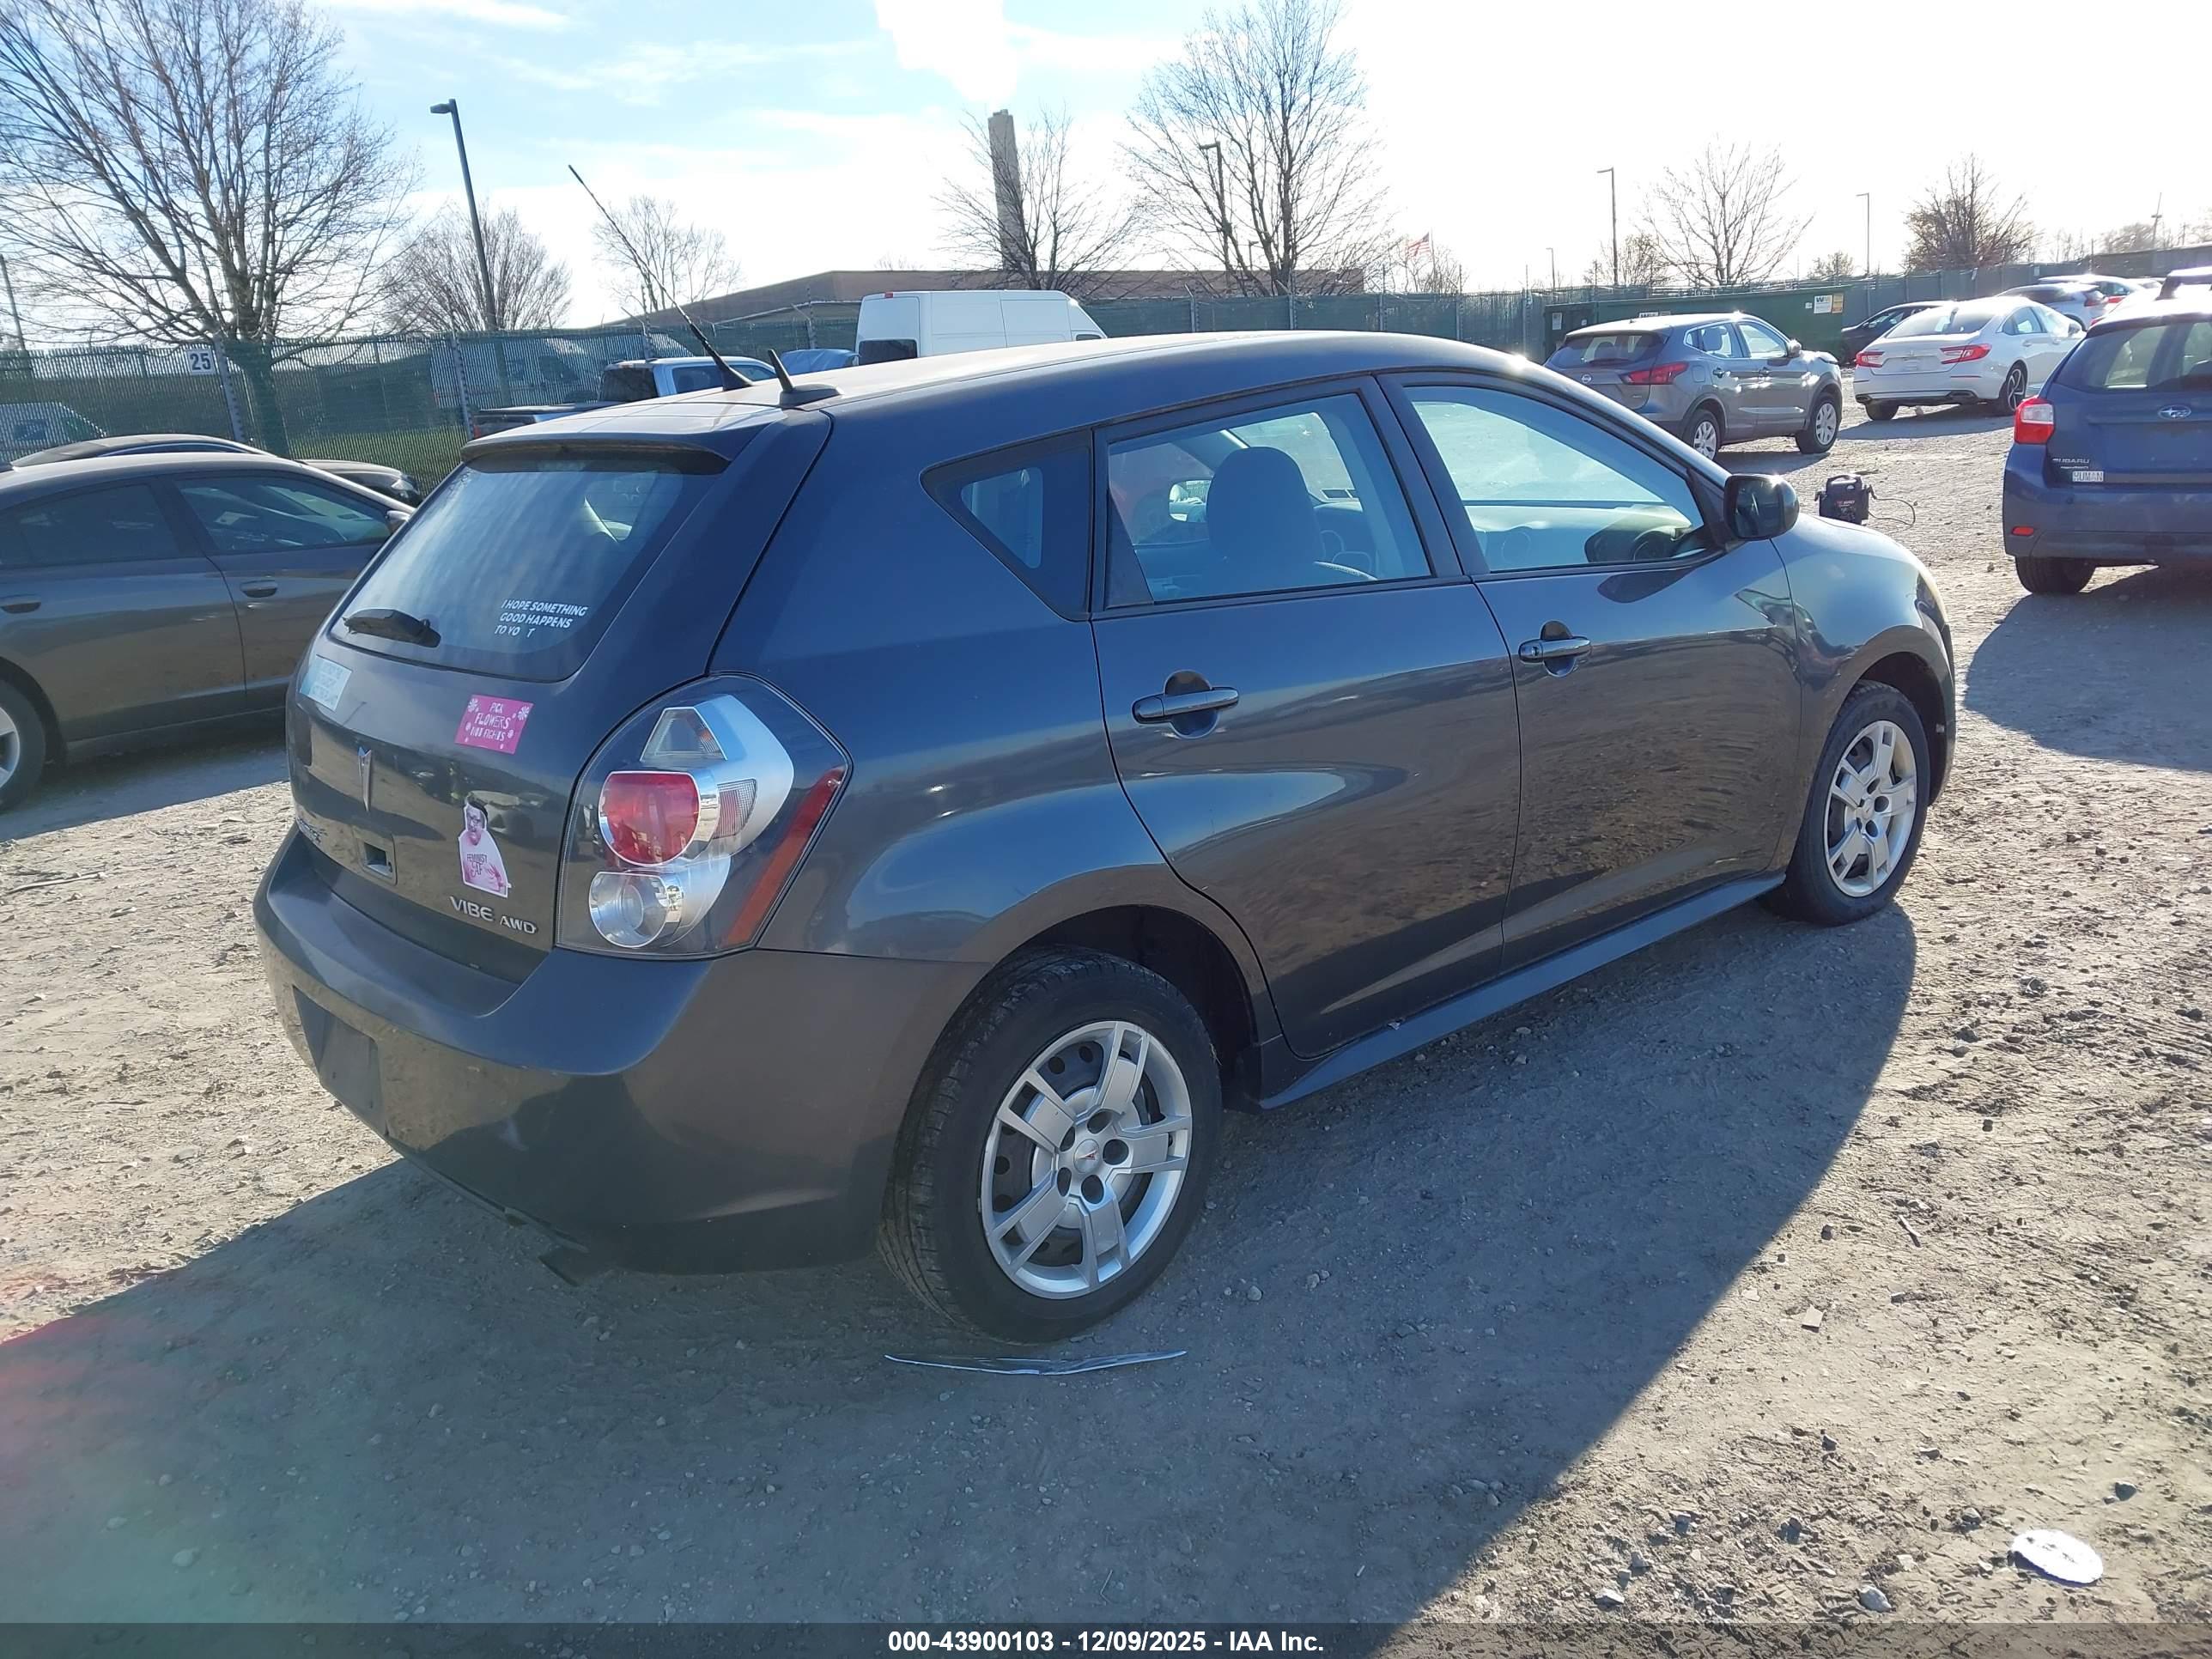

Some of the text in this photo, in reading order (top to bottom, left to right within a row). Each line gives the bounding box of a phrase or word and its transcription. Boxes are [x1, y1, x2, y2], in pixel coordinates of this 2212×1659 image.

[190, 352, 211, 370] 25
[2074, 471, 2103, 481] HUMAN
[501, 600, 588, 617] I HOPE SOMETHING
[500, 612, 574, 629] GOOD HAPPENS
[495, 624, 507, 635] TO
[474, 713, 511, 729] FLOWERS
[449, 896, 538, 934] VIBE AWD
